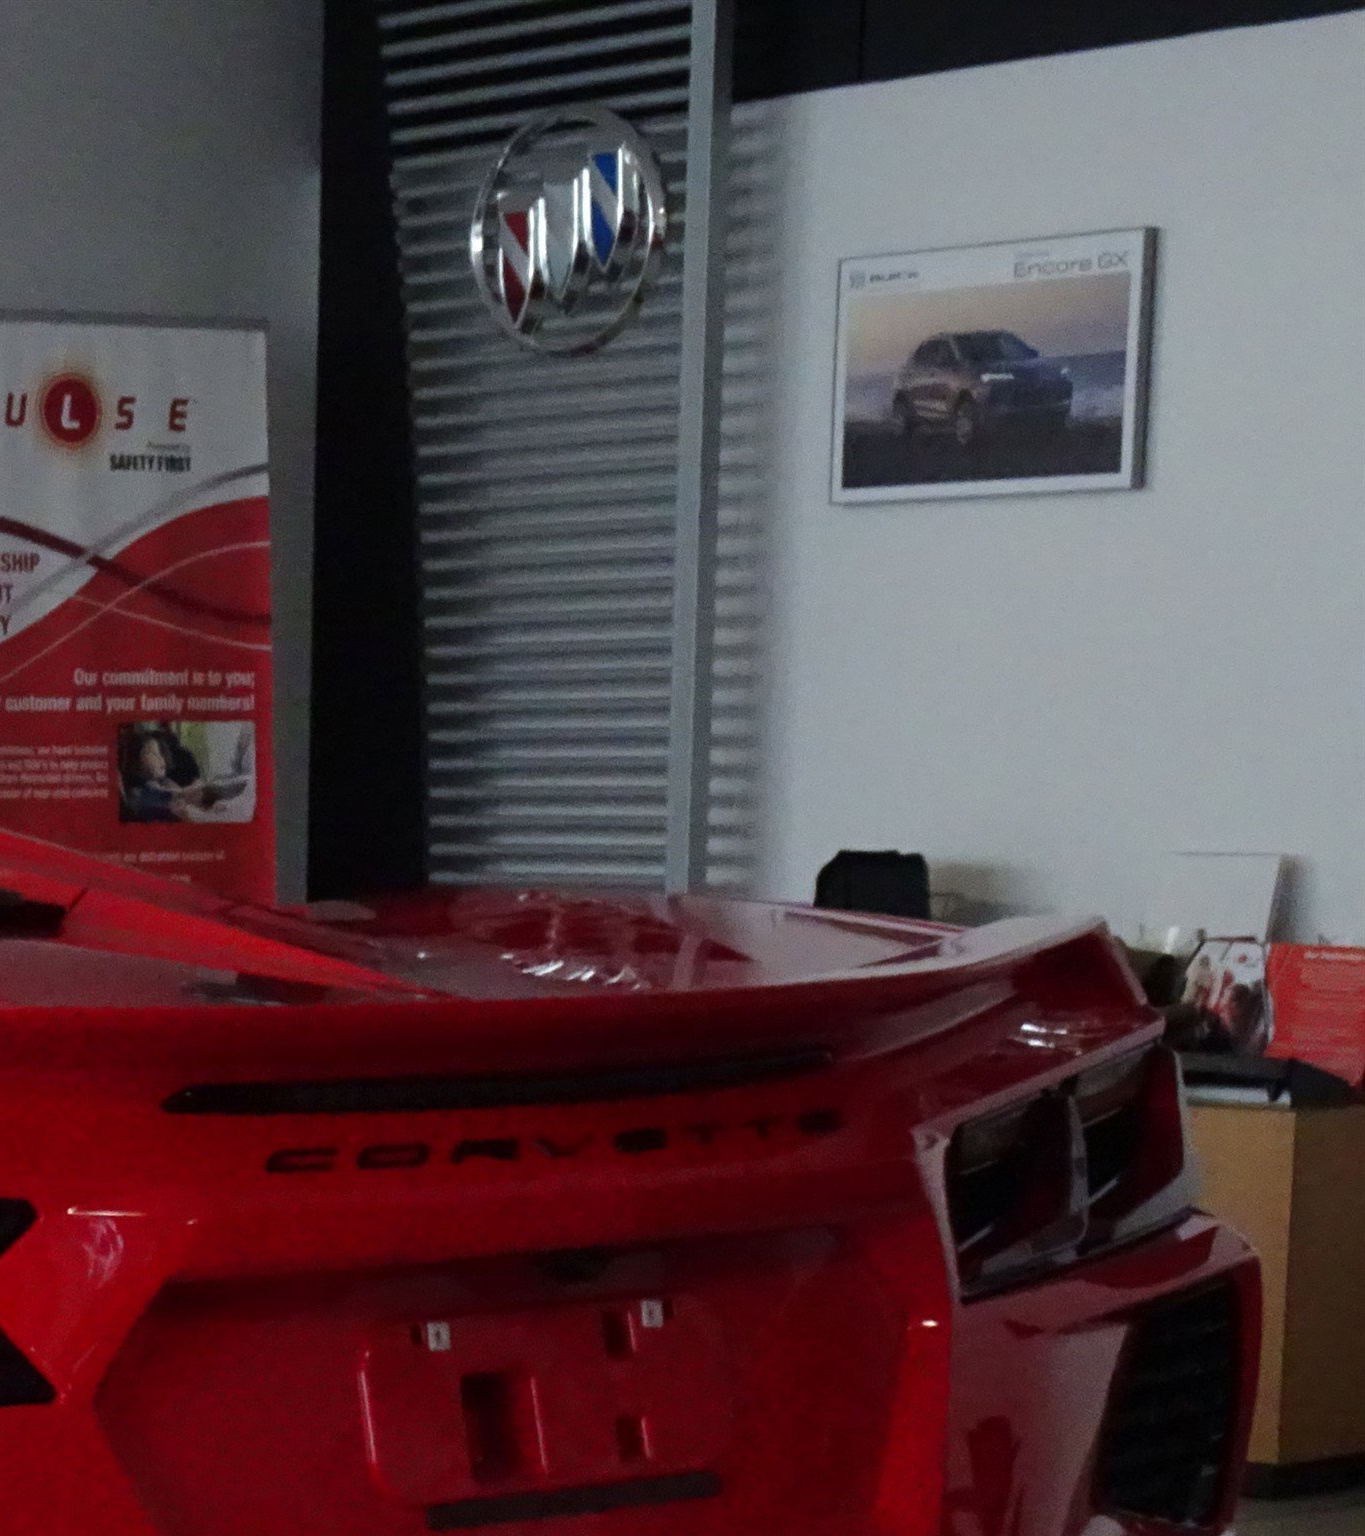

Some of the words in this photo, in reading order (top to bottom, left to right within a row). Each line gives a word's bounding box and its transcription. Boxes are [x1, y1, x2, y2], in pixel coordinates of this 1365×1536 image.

[1014, 258, 1093, 278] Encore
[1097, 251, 1128, 269] GX
[73, 668, 98, 686] Our
[102, 668, 189, 686] commitment
[76, 694, 102, 711] and
[106, 697, 137, 714] your
[264, 1108, 844, 1174] CORVETTE
